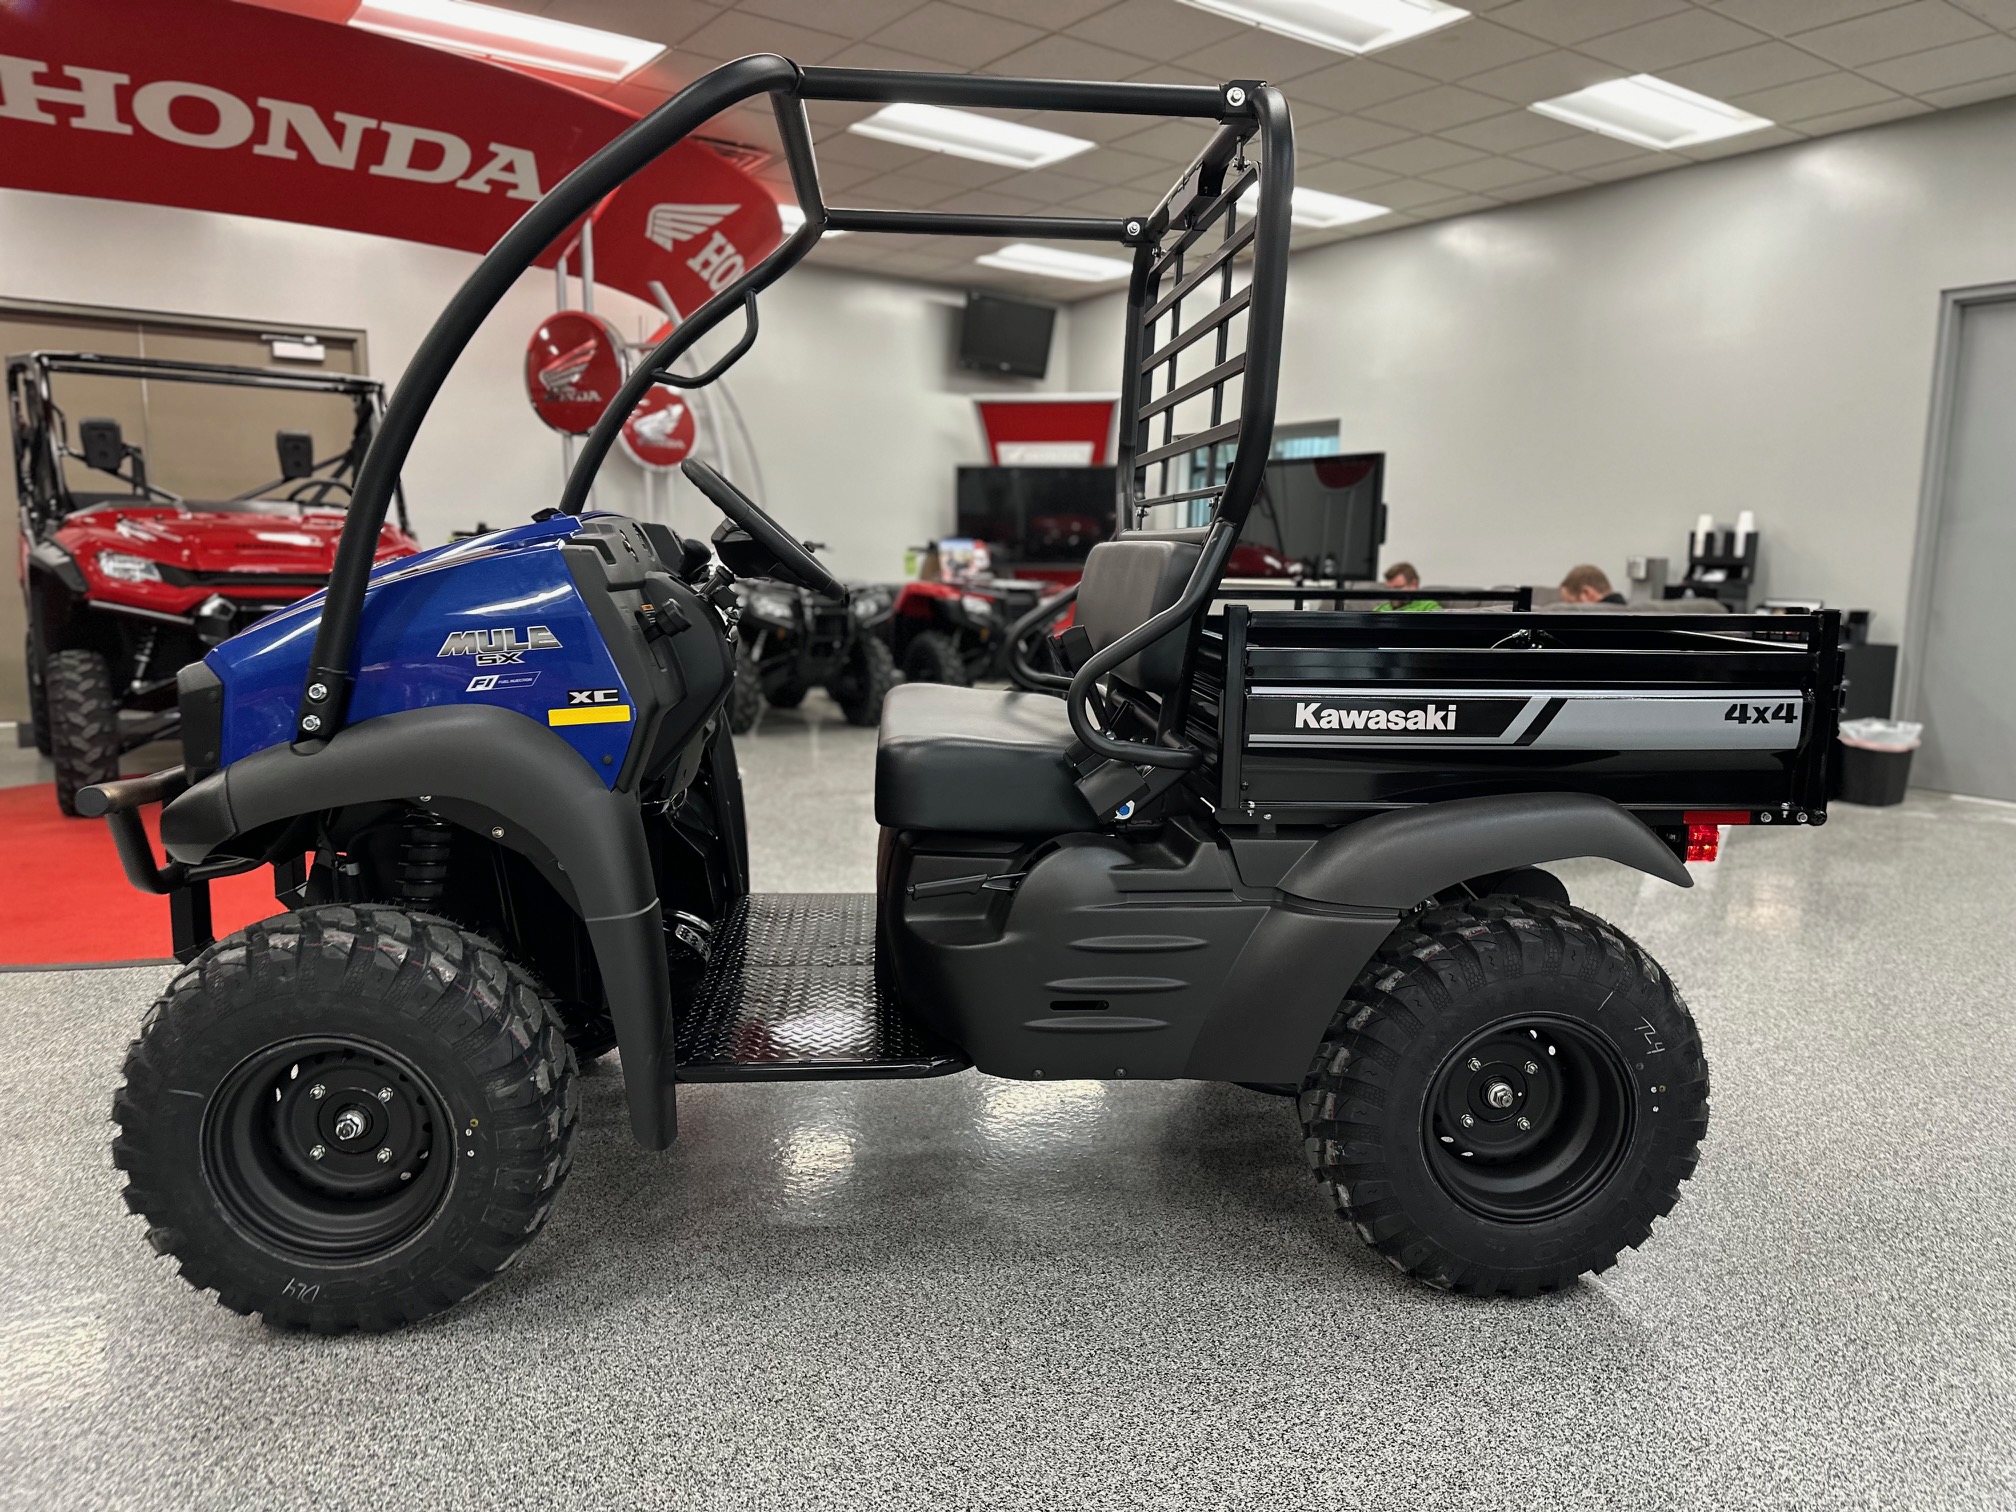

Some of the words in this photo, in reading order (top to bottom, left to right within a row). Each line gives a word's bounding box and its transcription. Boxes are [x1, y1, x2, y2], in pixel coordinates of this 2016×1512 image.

[0, 53, 545, 202] HONDA
[437, 625, 563, 658] MULE
[475, 650, 525, 667] SX
[568, 688, 619, 705] XC
[1295, 702, 1457, 731] Kawasaki
[1724, 703, 1798, 724] 4x4
